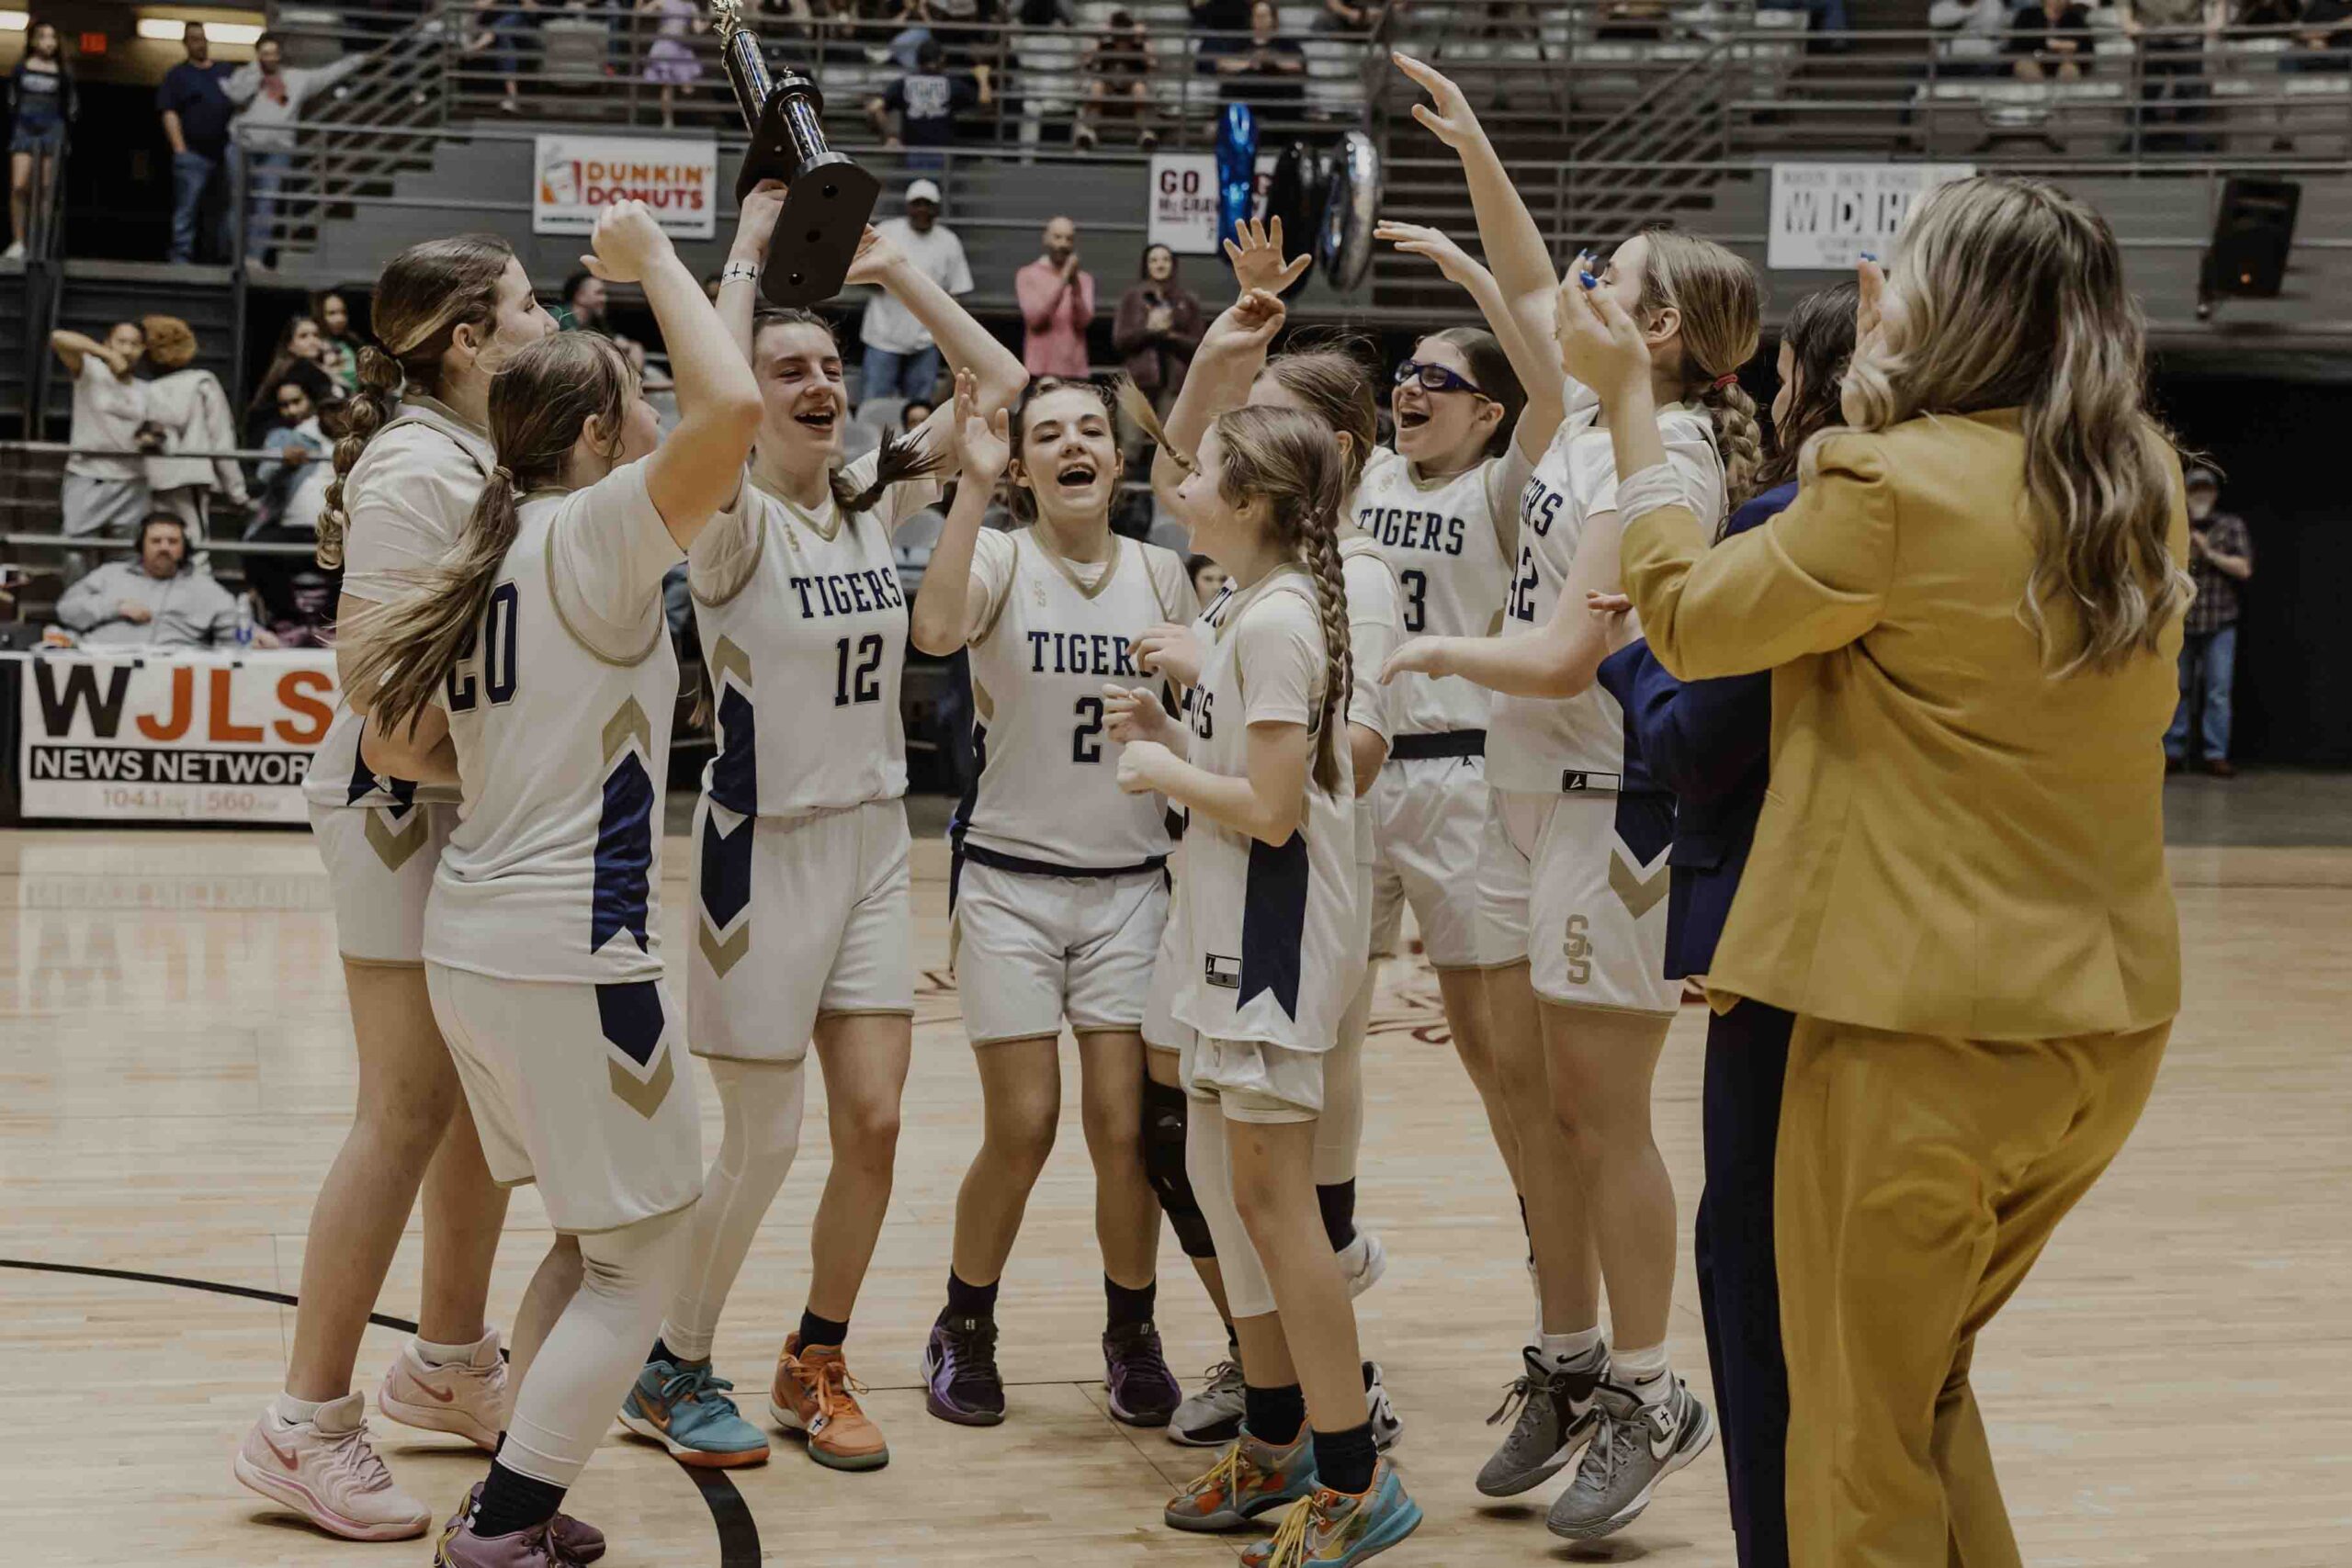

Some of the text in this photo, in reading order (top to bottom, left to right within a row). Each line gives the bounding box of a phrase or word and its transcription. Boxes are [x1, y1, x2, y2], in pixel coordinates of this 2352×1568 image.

[587, 186, 704, 211] DONUTS
[1160, 170, 1199, 194] GO
[1359, 508, 1465, 556] TIGERS
[791, 567, 902, 619] TIGERS
[1401, 569, 1427, 632] 3
[835, 634, 884, 706] 12
[33, 656, 334, 746] WJLS
[1073, 696, 1104, 763] 2
[34, 749, 312, 783] NEWS NETWOR
